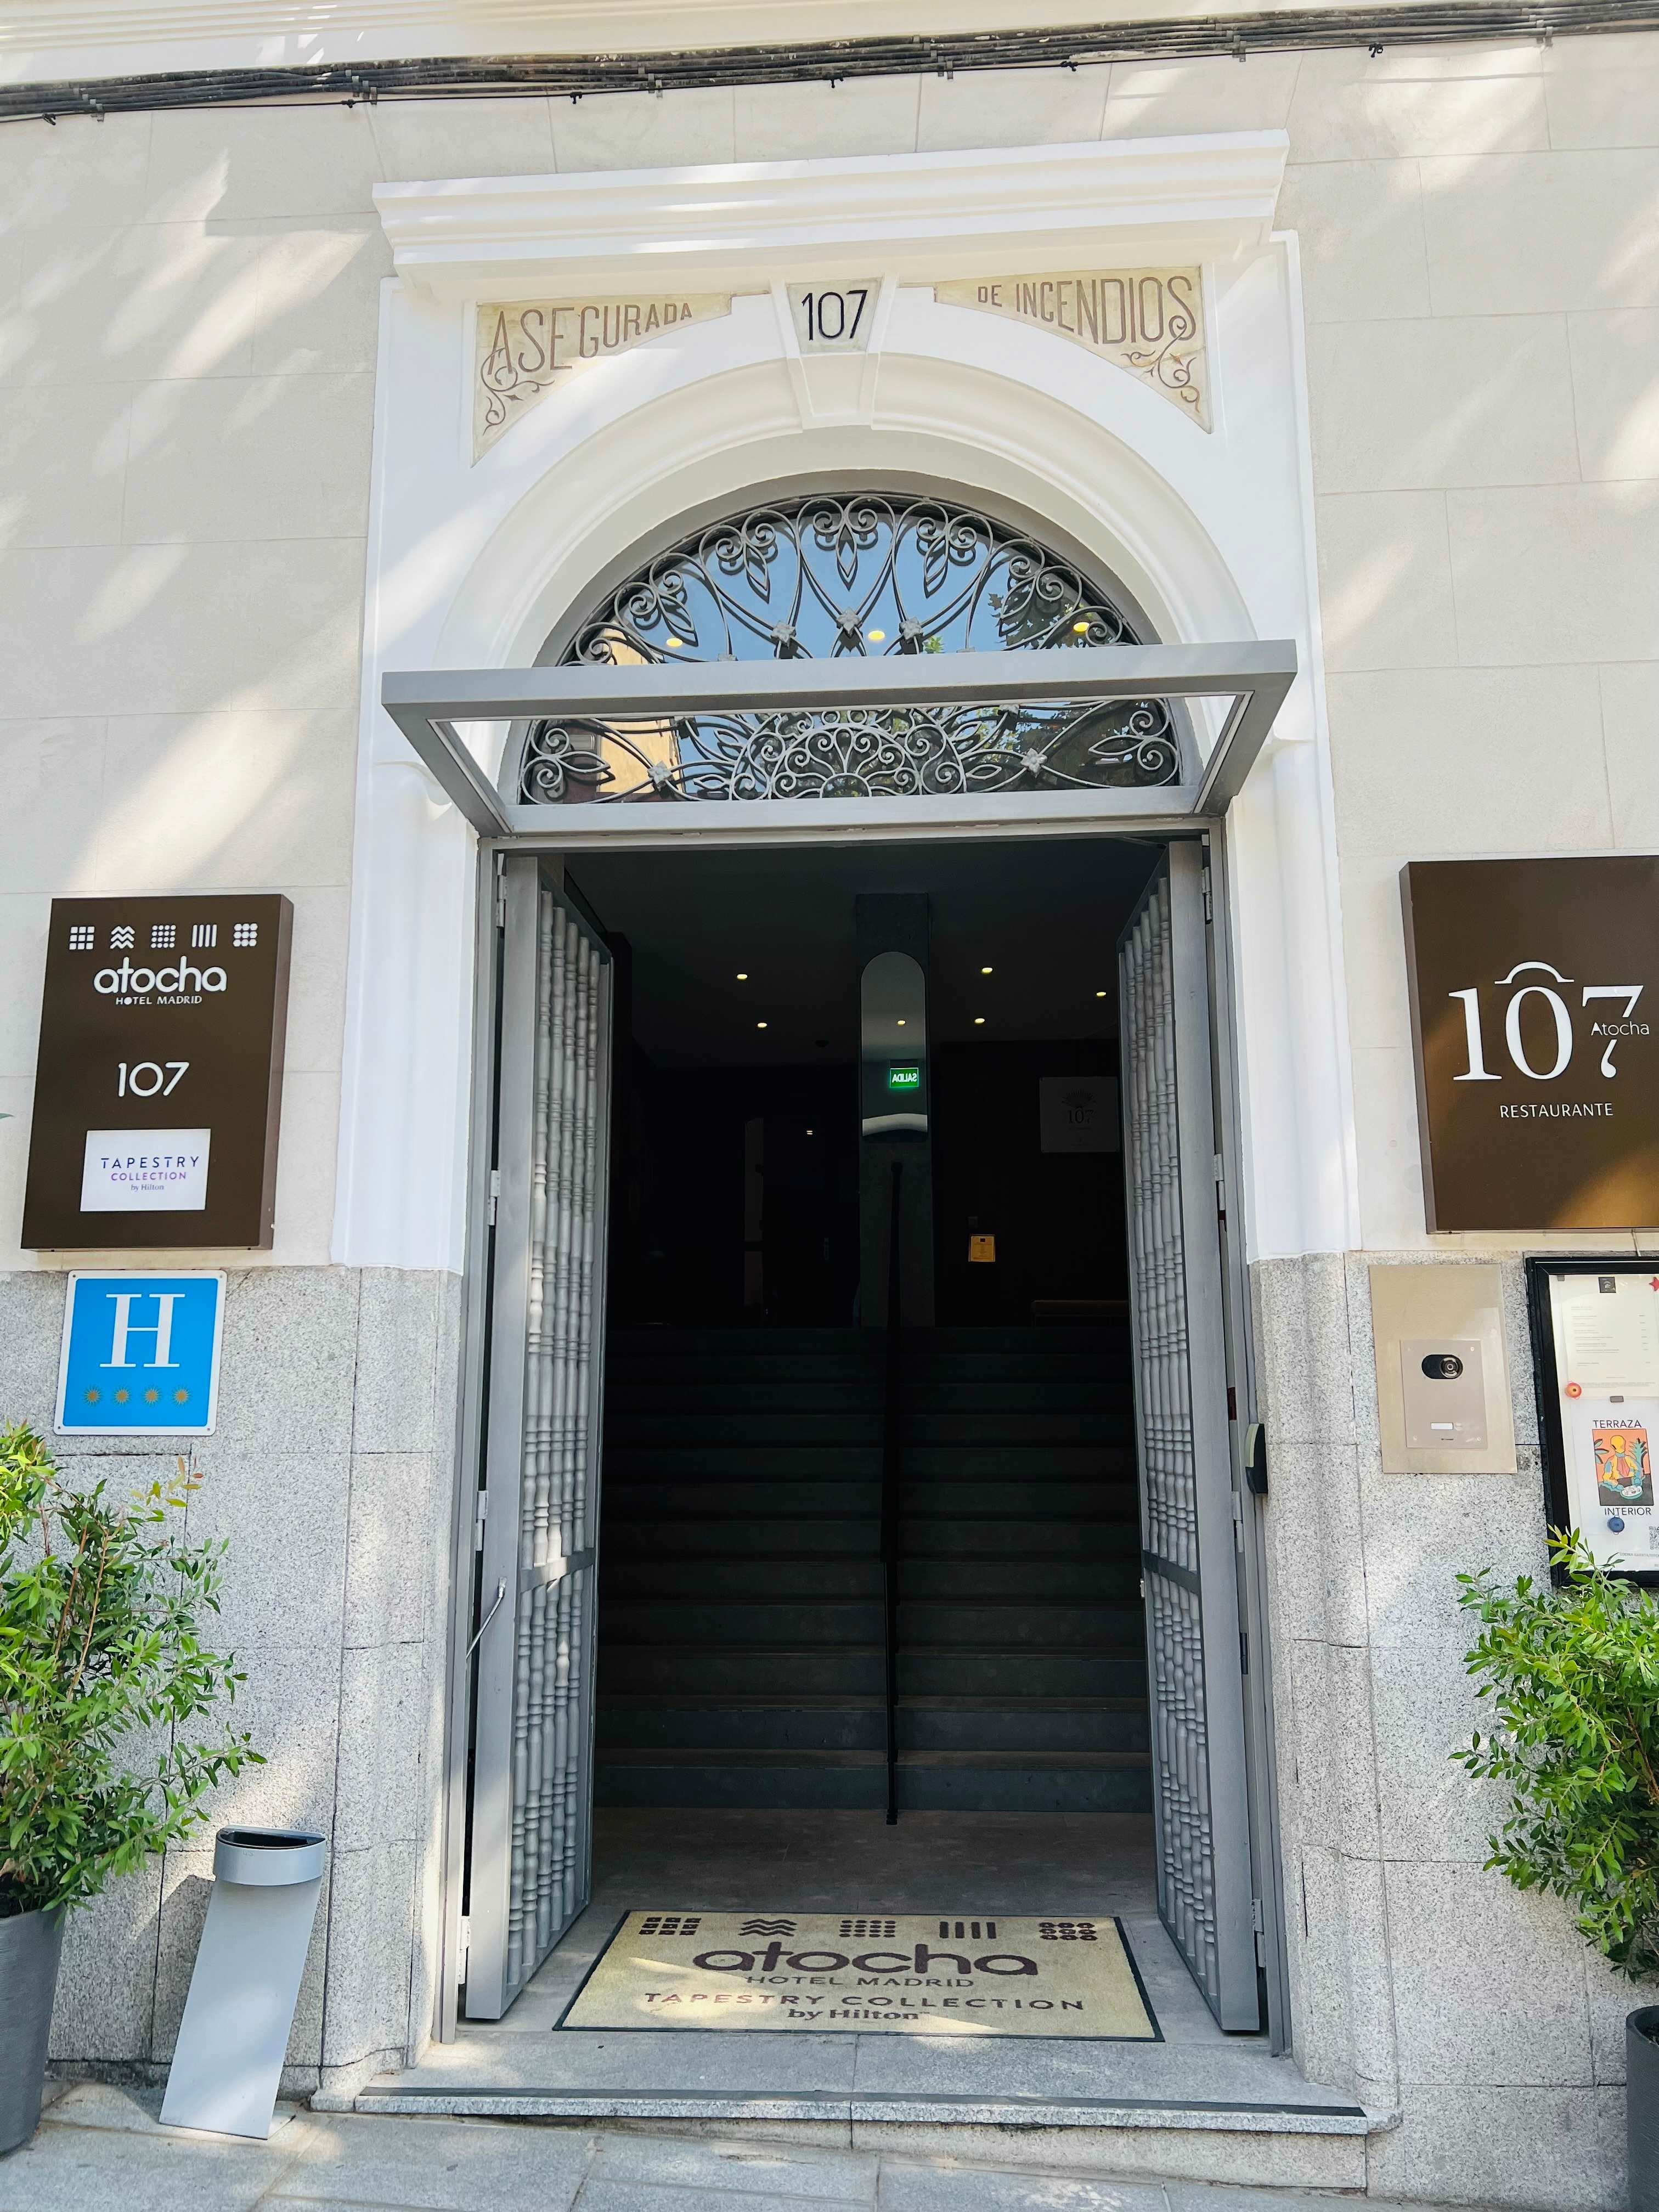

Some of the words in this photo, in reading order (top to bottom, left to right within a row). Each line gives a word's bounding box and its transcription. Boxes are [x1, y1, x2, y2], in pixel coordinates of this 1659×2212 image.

[801, 289, 868, 341] 107
[977, 285, 1003, 308] DE
[1016, 275, 1197, 345] INCENDIOS
[487, 302, 693, 371] ASEGURADA
[93, 955, 227, 994] atocha
[115, 996, 153, 1006] HOTEL
[156, 995, 202, 1005] MADRID
[1448, 985, 1644, 1081] 107
[1590, 1021, 1650, 1036] Atocha
[117, 1061, 190, 1097] 107
[1499, 1103, 1614, 1118] RESTAURANTE
[100, 1156, 199, 1169] TAPESTRY
[111, 1171, 187, 1181] COLLECTION
[131, 1184, 139, 1192] by
[99, 1294, 185, 1368] H
[1593, 1420, 1642, 1429] TERRAZA
[1604, 1507, 1652, 1516] INTERIOR
[692, 1941, 1039, 1976] atocha
[747, 1976, 843, 1985] HOTEL
[856, 1977, 974, 1988] MADRID
[645, 1993, 825, 2005] TAPESTRY
[841, 1995, 1084, 2011] COLLECTION
[787, 2008, 823, 2021] by
